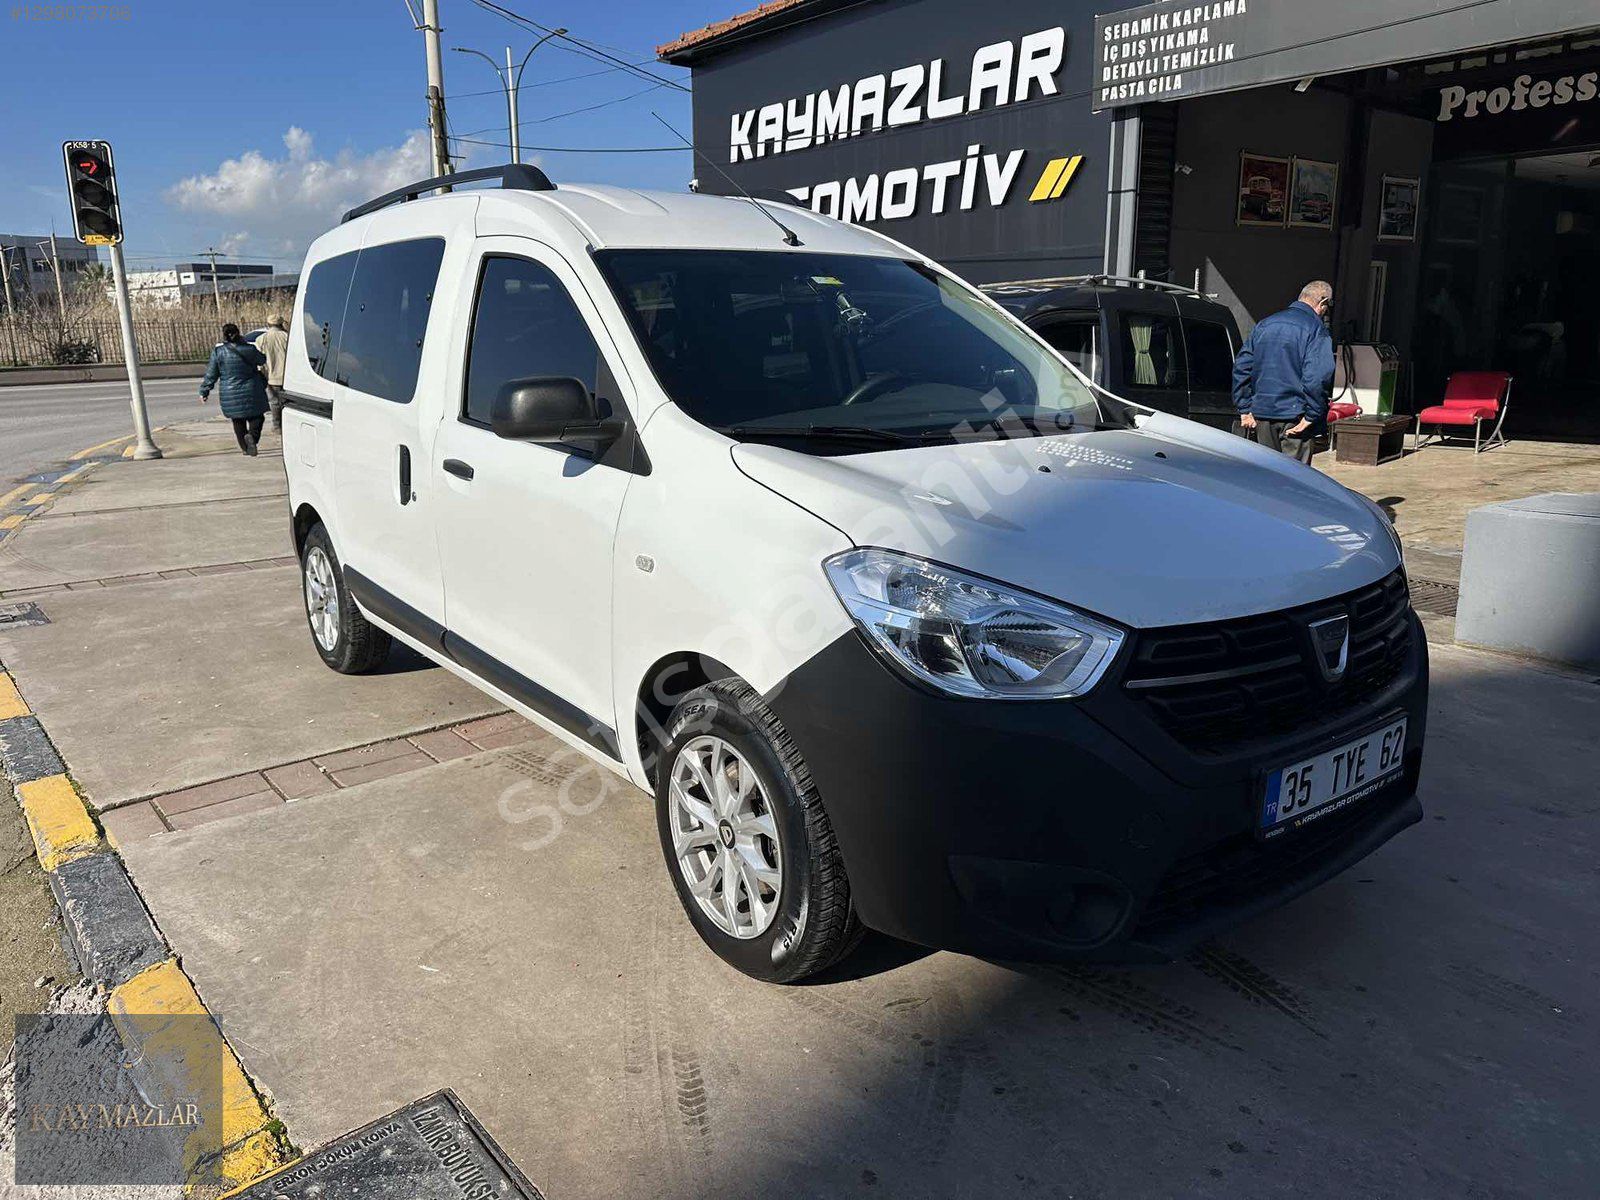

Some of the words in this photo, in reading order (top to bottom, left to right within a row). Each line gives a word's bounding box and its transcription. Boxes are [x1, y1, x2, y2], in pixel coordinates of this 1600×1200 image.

[1104, 13, 1169, 42] SERAMİK
[1173, 0, 1247, 28] KAPLAMA
[1102, 57, 1158, 82] DETAYLI
[1163, 43, 1235, 71] TEMİZLİK
[1103, 44, 1119, 63] İÇ
[1121, 40, 1147, 59] DIŞ
[1150, 27, 1209, 53] YIKAMA
[729, 26, 1066, 164] KAYMAZLAR
[1101, 82, 1145, 102] PASTA
[1437, 72, 1600, 121] Profess
[785, 144, 1025, 224] OMOTİV
[1282, 764, 1314, 813] 35
[1332, 741, 1370, 795] TYE
[1379, 725, 1404, 770] 62
[1266, 802, 1278, 816] TR
[360, 1121, 403, 1147] KONYA
